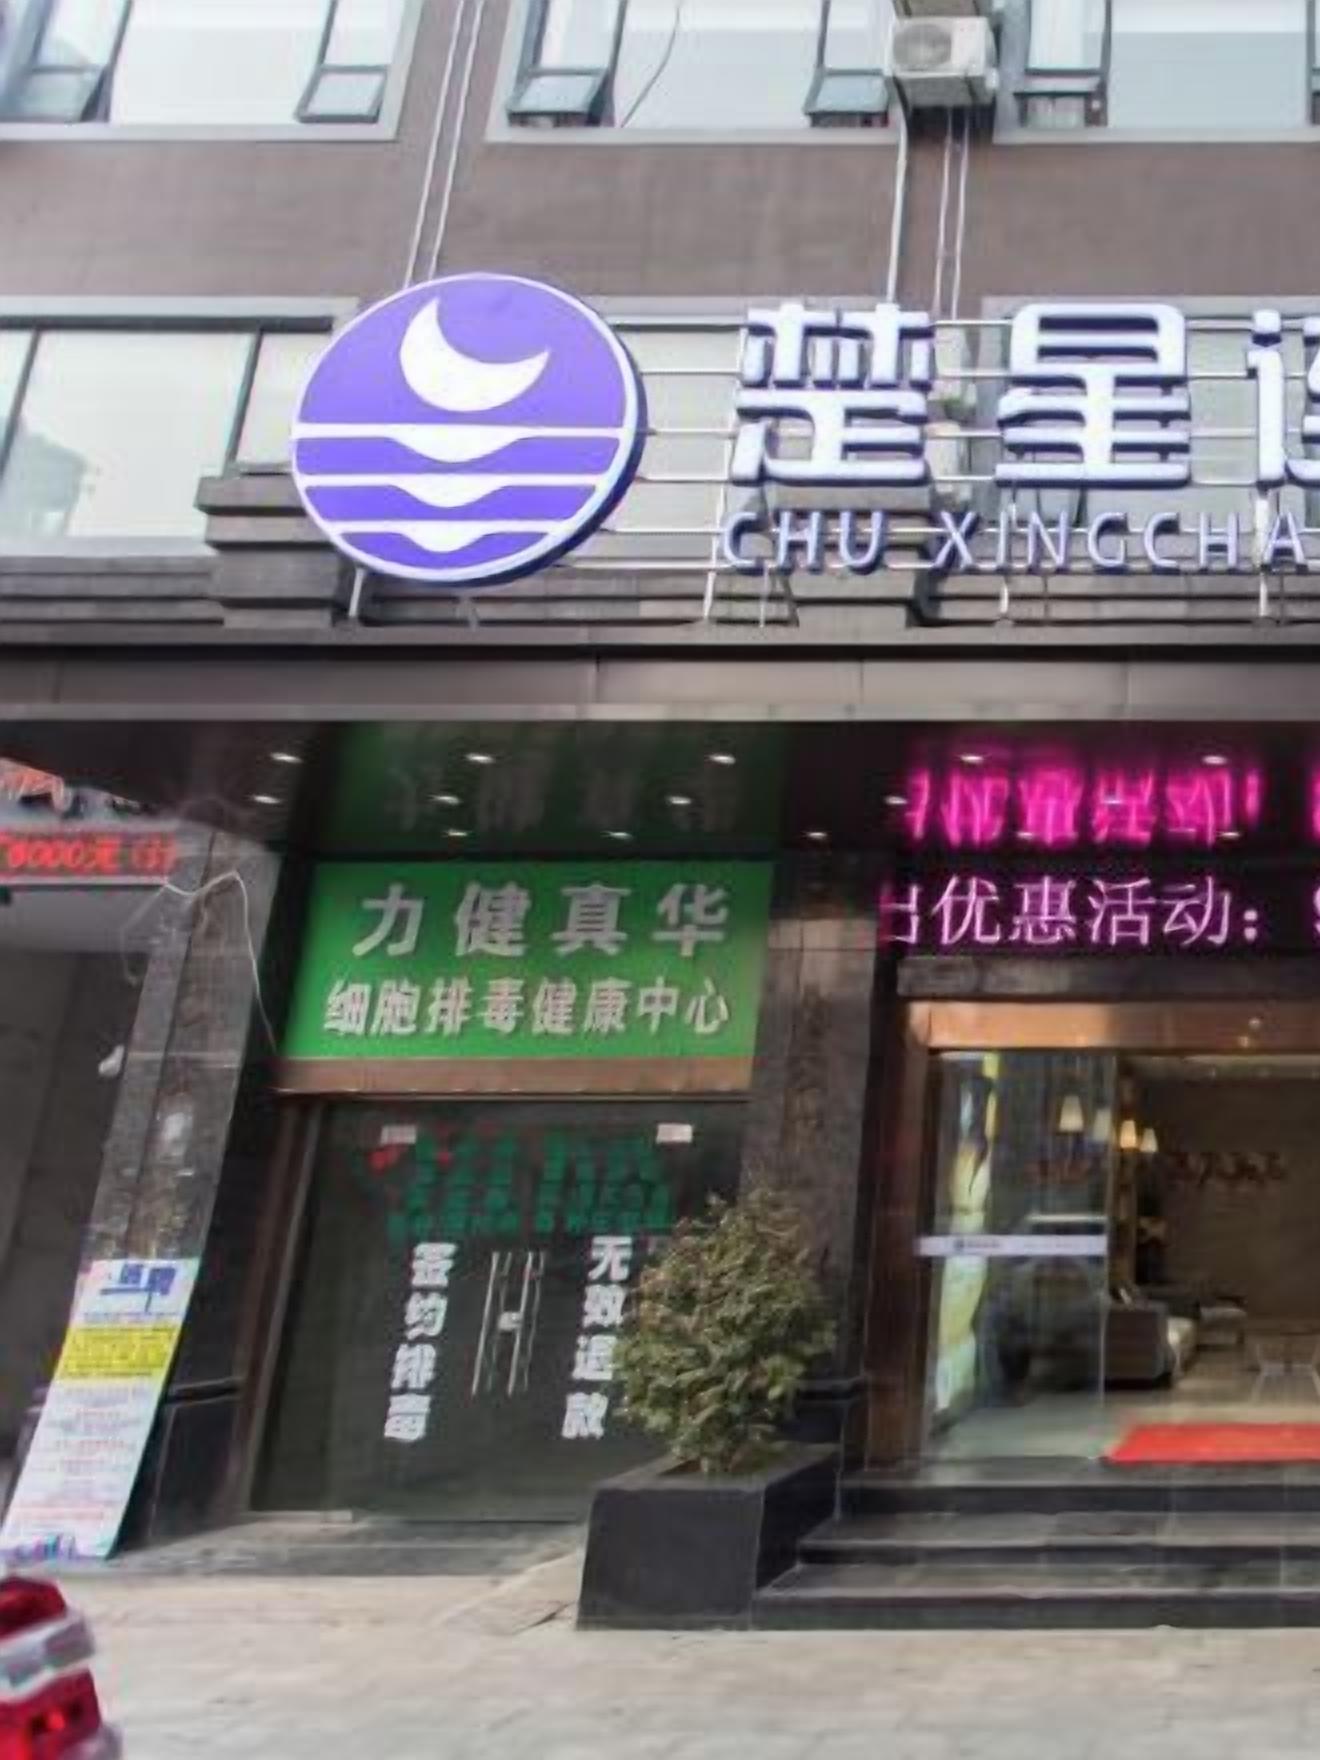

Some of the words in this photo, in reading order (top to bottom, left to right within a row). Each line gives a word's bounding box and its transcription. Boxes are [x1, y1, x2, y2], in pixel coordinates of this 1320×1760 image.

[721, 510, 889, 573] CHU
[352, 880, 729, 958] 力健真华
[323, 975, 731, 1036] 细胞排毒健康中心
